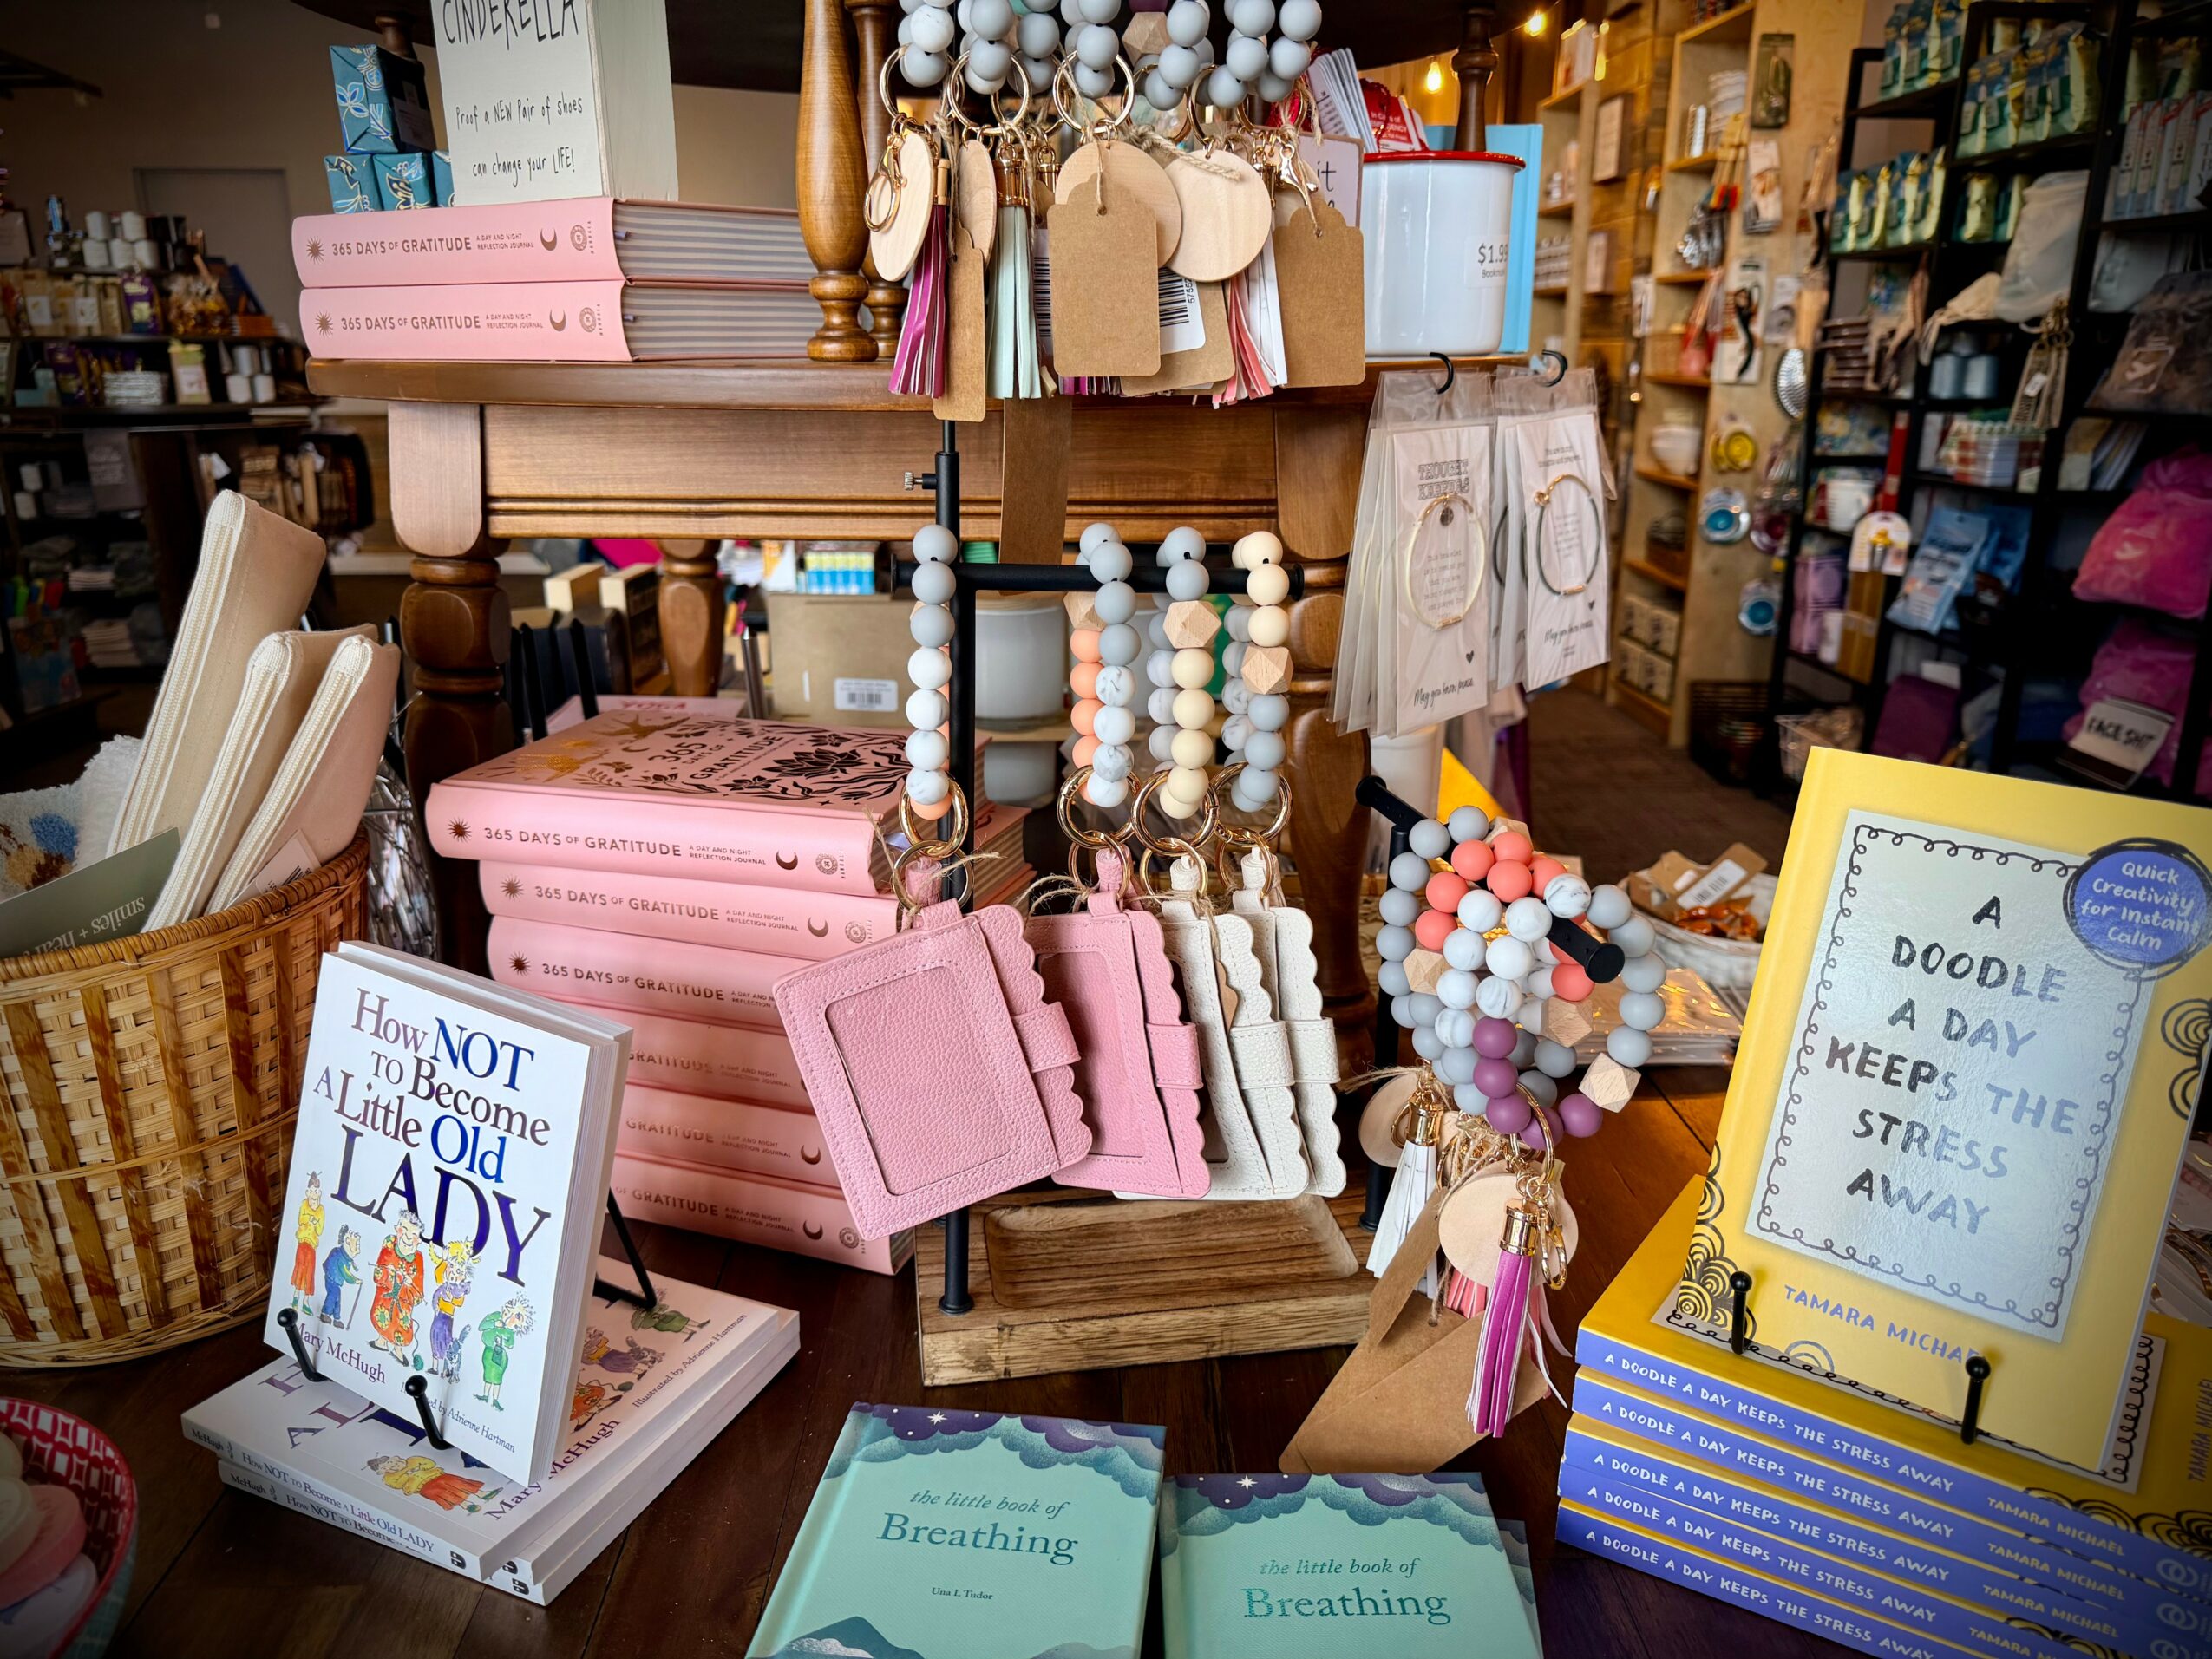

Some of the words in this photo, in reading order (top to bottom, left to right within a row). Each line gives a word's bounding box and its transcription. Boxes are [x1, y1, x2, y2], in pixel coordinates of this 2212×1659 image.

[455, 105, 478, 132] Proof
[484, 110, 490, 125] a
[494, 100, 512, 123] NEW
[541, 96, 551, 124] of
[557, 92, 583, 115] shoes
[473, 162, 487, 177] can
[492, 152, 521, 187] change
[527, 157, 546, 181] your
[553, 147, 575, 173] LIFE!
[332, 243, 352, 256] 365
[357, 240, 386, 255] DAYS
[389, 241, 399, 250] OF
[402, 237, 472, 253] GRATITUDE
[341, 317, 361, 330] 365
[365, 317, 396, 330] DAYS
[398, 317, 408, 326] OF
[411, 315, 481, 330] GRATITUDE
[648, 742, 707, 762] 365
[690, 736, 784, 780] GRATITUDE
[484, 827, 513, 841] 365
[520, 831, 561, 846] DAYS
[566, 835, 579, 844] OF
[585, 837, 682, 857] GRATITUDE
[690, 853, 731, 862] REFLECTION
[734, 857, 766, 865] JOURNAL
[90, 896, 146, 935] smiles
[535, 886, 561, 899] 365
[567, 890, 607, 905] DAYS
[629, 898, 719, 920] GRATITUDE
[1972, 895, 2002, 929] A
[2081, 899, 2115, 916] for
[2092, 878, 2195, 917] Creativity
[2108, 926, 2162, 951] Calm
[542, 963, 568, 977] 365
[574, 968, 613, 984] DAYS
[634, 977, 724, 1001] GRATITUDE
[1891, 934, 2067, 1002] DOODLE
[351, 988, 429, 1054] How
[430, 1016, 535, 1092] NOT
[1888, 997, 1915, 1031] A
[1942, 1007, 2037, 1058] DAY
[371, 1050, 404, 1085] TO
[408, 1055, 550, 1146] Become
[1825, 1035, 1958, 1101] KEEPS
[1986, 1083, 2079, 1134] THE
[313, 1066, 334, 1101] A
[334, 1069, 422, 1148] Little
[431, 1114, 507, 1183] Old
[1852, 1108, 2009, 1179] STRESS
[330, 1124, 552, 1287] LADY
[632, 1189, 719, 1217] GRATITUDE
[1847, 1168, 1990, 1235] AWAY
[1784, 1284, 1875, 1331] TAMARA
[326, 1337, 386, 1384] McHugh
[632, 1376, 673, 1408] Illustrated
[670, 1366, 683, 1381] by
[681, 1341, 714, 1368] Adrienne
[712, 1314, 747, 1342] Hartman
[192, 1429, 224, 1451] McHugh
[438, 1401, 447, 1418] by
[447, 1405, 480, 1434] Adrienne
[481, 1425, 515, 1453] Hartman
[1605, 1354, 1615, 1365] A
[1621, 1358, 1677, 1388] DOODLE
[1682, 1383, 1692, 1395] A
[1700, 1388, 1731, 1408] DAY
[1738, 1401, 1786, 1429] KEEPS
[1794, 1424, 1825, 1444] THE
[1832, 1439, 1891, 1469] STRESS
[1898, 1465, 1953, 1492] AWAY
[484, 1479, 541, 1521] Mary
[547, 1419, 620, 1479] McHugh
[1602, 1401, 1613, 1414] A
[1620, 1407, 1675, 1435] DOODLE
[1681, 1431, 1692, 1442] A
[1699, 1436, 1730, 1455] DAY
[1737, 1449, 1785, 1477] KEEPS
[1793, 1471, 1825, 1492] THE
[1831, 1486, 1891, 1515] STRESS
[1898, 1511, 1954, 1538] AWAY
[2188, 1432, 2211, 1483] TAMARA
[231, 1473, 265, 1494] McHugh
[242, 1452, 263, 1471] How
[264, 1462, 289, 1482] NOT
[291, 1477, 303, 1488] TO
[304, 1480, 342, 1509] Become
[343, 1503, 349, 1512] A
[350, 1505, 376, 1525] Little
[377, 1518, 396, 1536] Old
[398, 1526, 434, 1552] LADY
[910, 1490, 941, 1505] the
[946, 1492, 991, 1510] little
[997, 1497, 1040, 1513] book
[1045, 1501, 1071, 1519] of
[286, 1494, 309, 1511] How
[311, 1503, 338, 1522] NOT
[341, 1514, 352, 1526] TO
[354, 1519, 395, 1544] Become
[876, 1512, 1078, 1565] Breathing
[1987, 1497, 2050, 1528] TAMARA
[2057, 1523, 2124, 1556] MICHAEL
[1260, 1559, 1289, 1575] the
[1296, 1558, 1342, 1574] little
[1349, 1558, 1393, 1574] book
[1399, 1558, 1421, 1578] of
[1987, 1543, 2050, 1573] TAMARA
[2057, 1568, 2124, 1600] MICHAEL
[932, 1587, 951, 1597] Una
[963, 1590, 993, 1600] Tudor
[1240, 1586, 1451, 1625] Breathing
